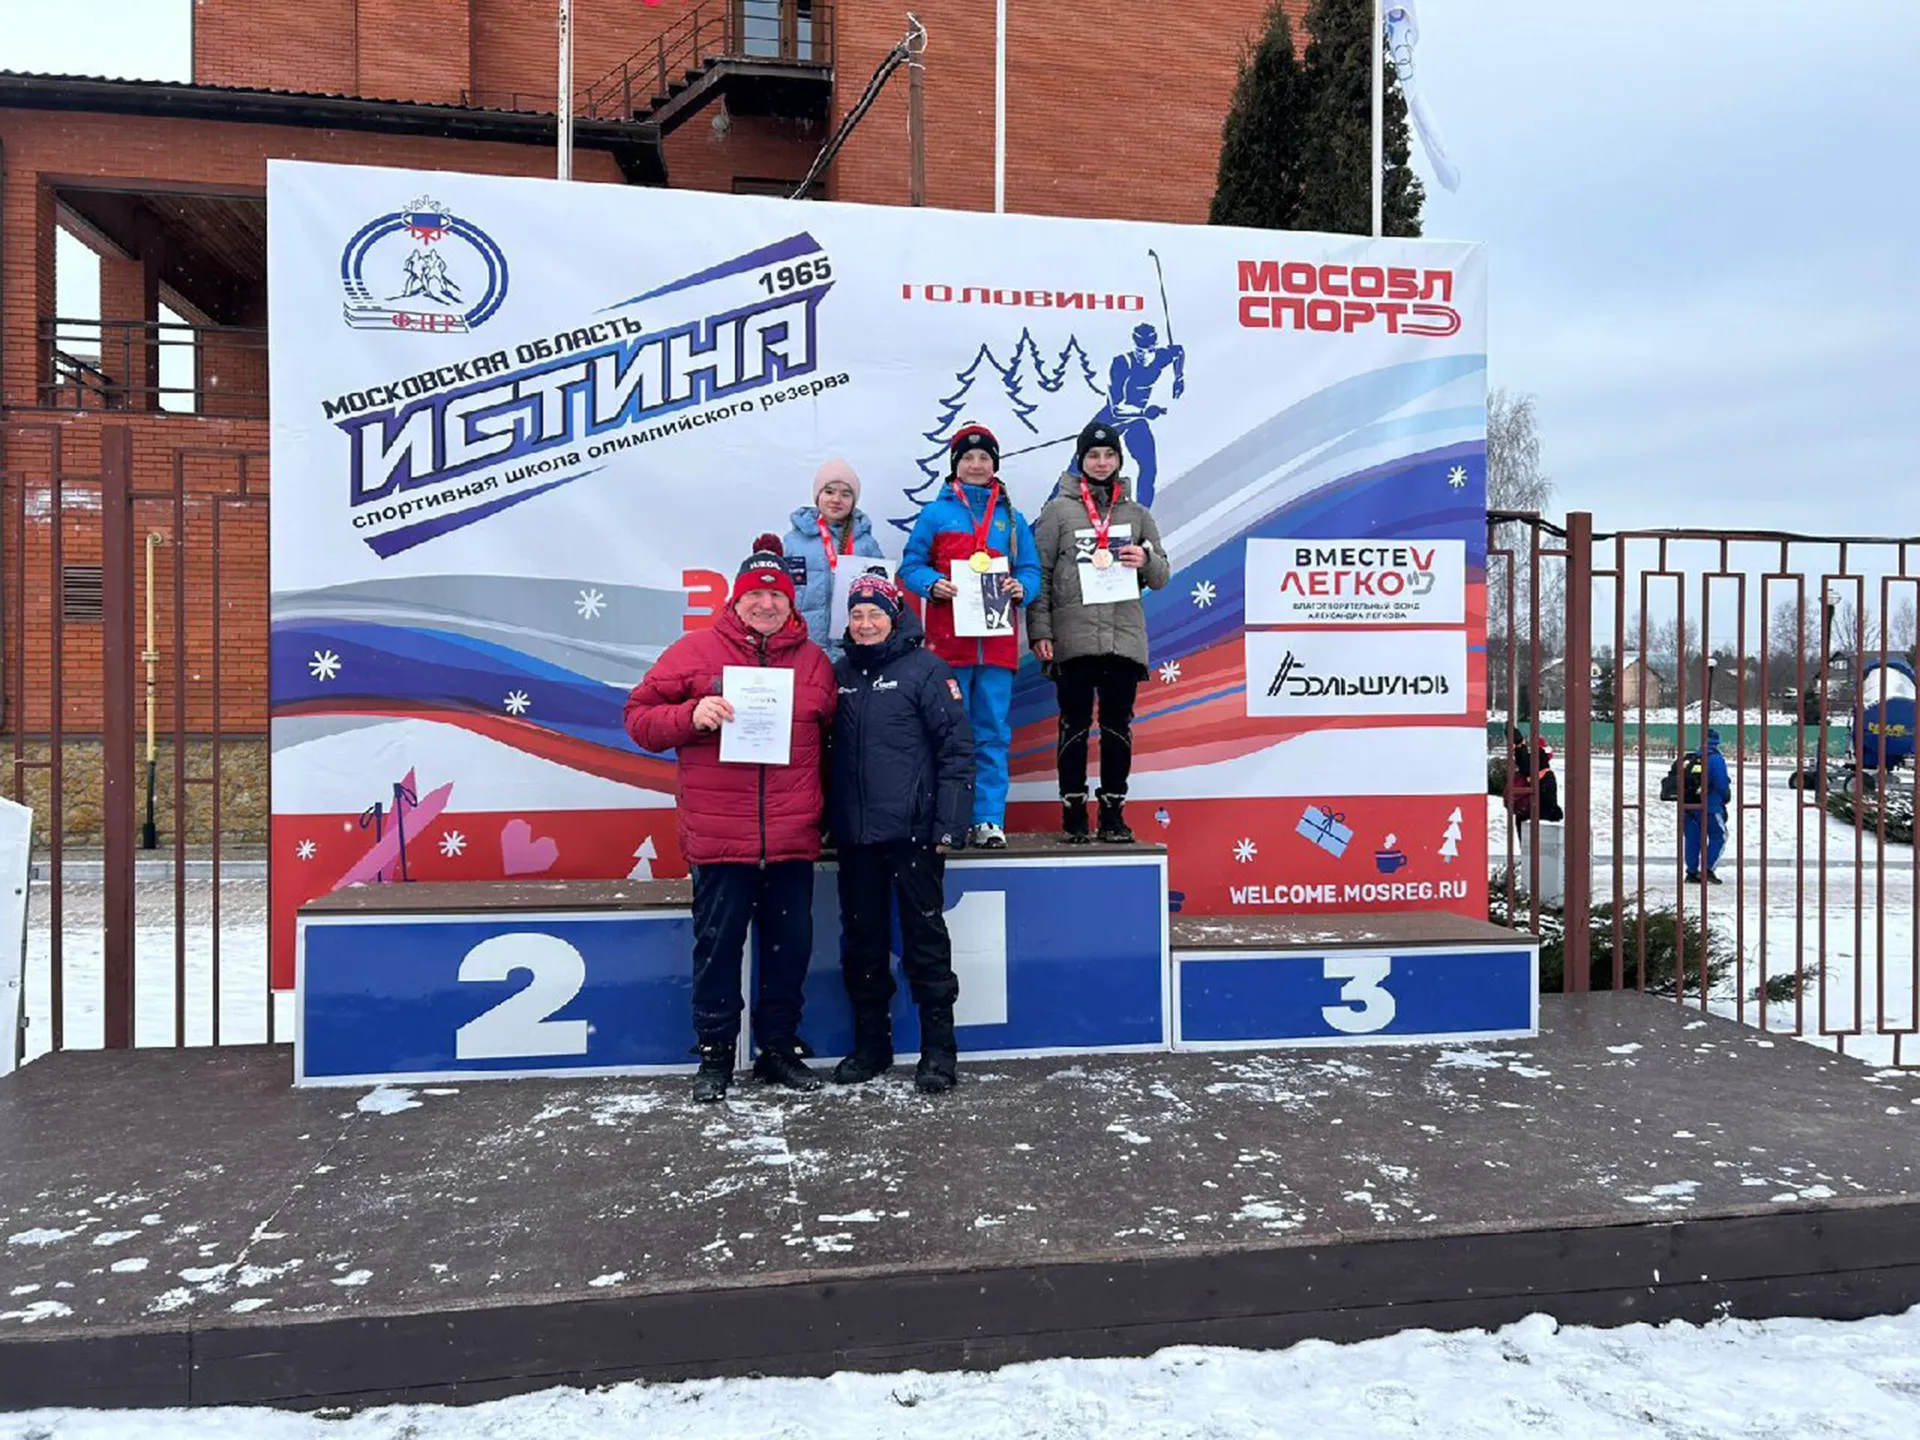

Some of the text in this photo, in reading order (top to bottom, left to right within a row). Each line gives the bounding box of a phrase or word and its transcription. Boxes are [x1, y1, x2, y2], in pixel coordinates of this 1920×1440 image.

[758, 256, 833, 296] 1965
[1237, 260, 1453, 302] МОСОБЛ
[902, 283, 1144, 312] ГОЛОВИНО
[1238, 297, 1410, 336] СПОРТ
[322, 315, 643, 419] МОСКОВСКАЯ ОБЛАСТЬ
[340, 286, 832, 506] ИСТИНА
[352, 372, 851, 529] спортивная школа олимпийского резерва
[1295, 547, 1408, 567] ВМЕСТЕ
[1280, 571, 1405, 596] ЛЕГКО
[1230, 880, 1467, 905] WELCOME.MOSREG.RU
[943, 891, 1008, 1026] 1
[455, 932, 588, 1060] 2
[1321, 956, 1396, 1034] 3
